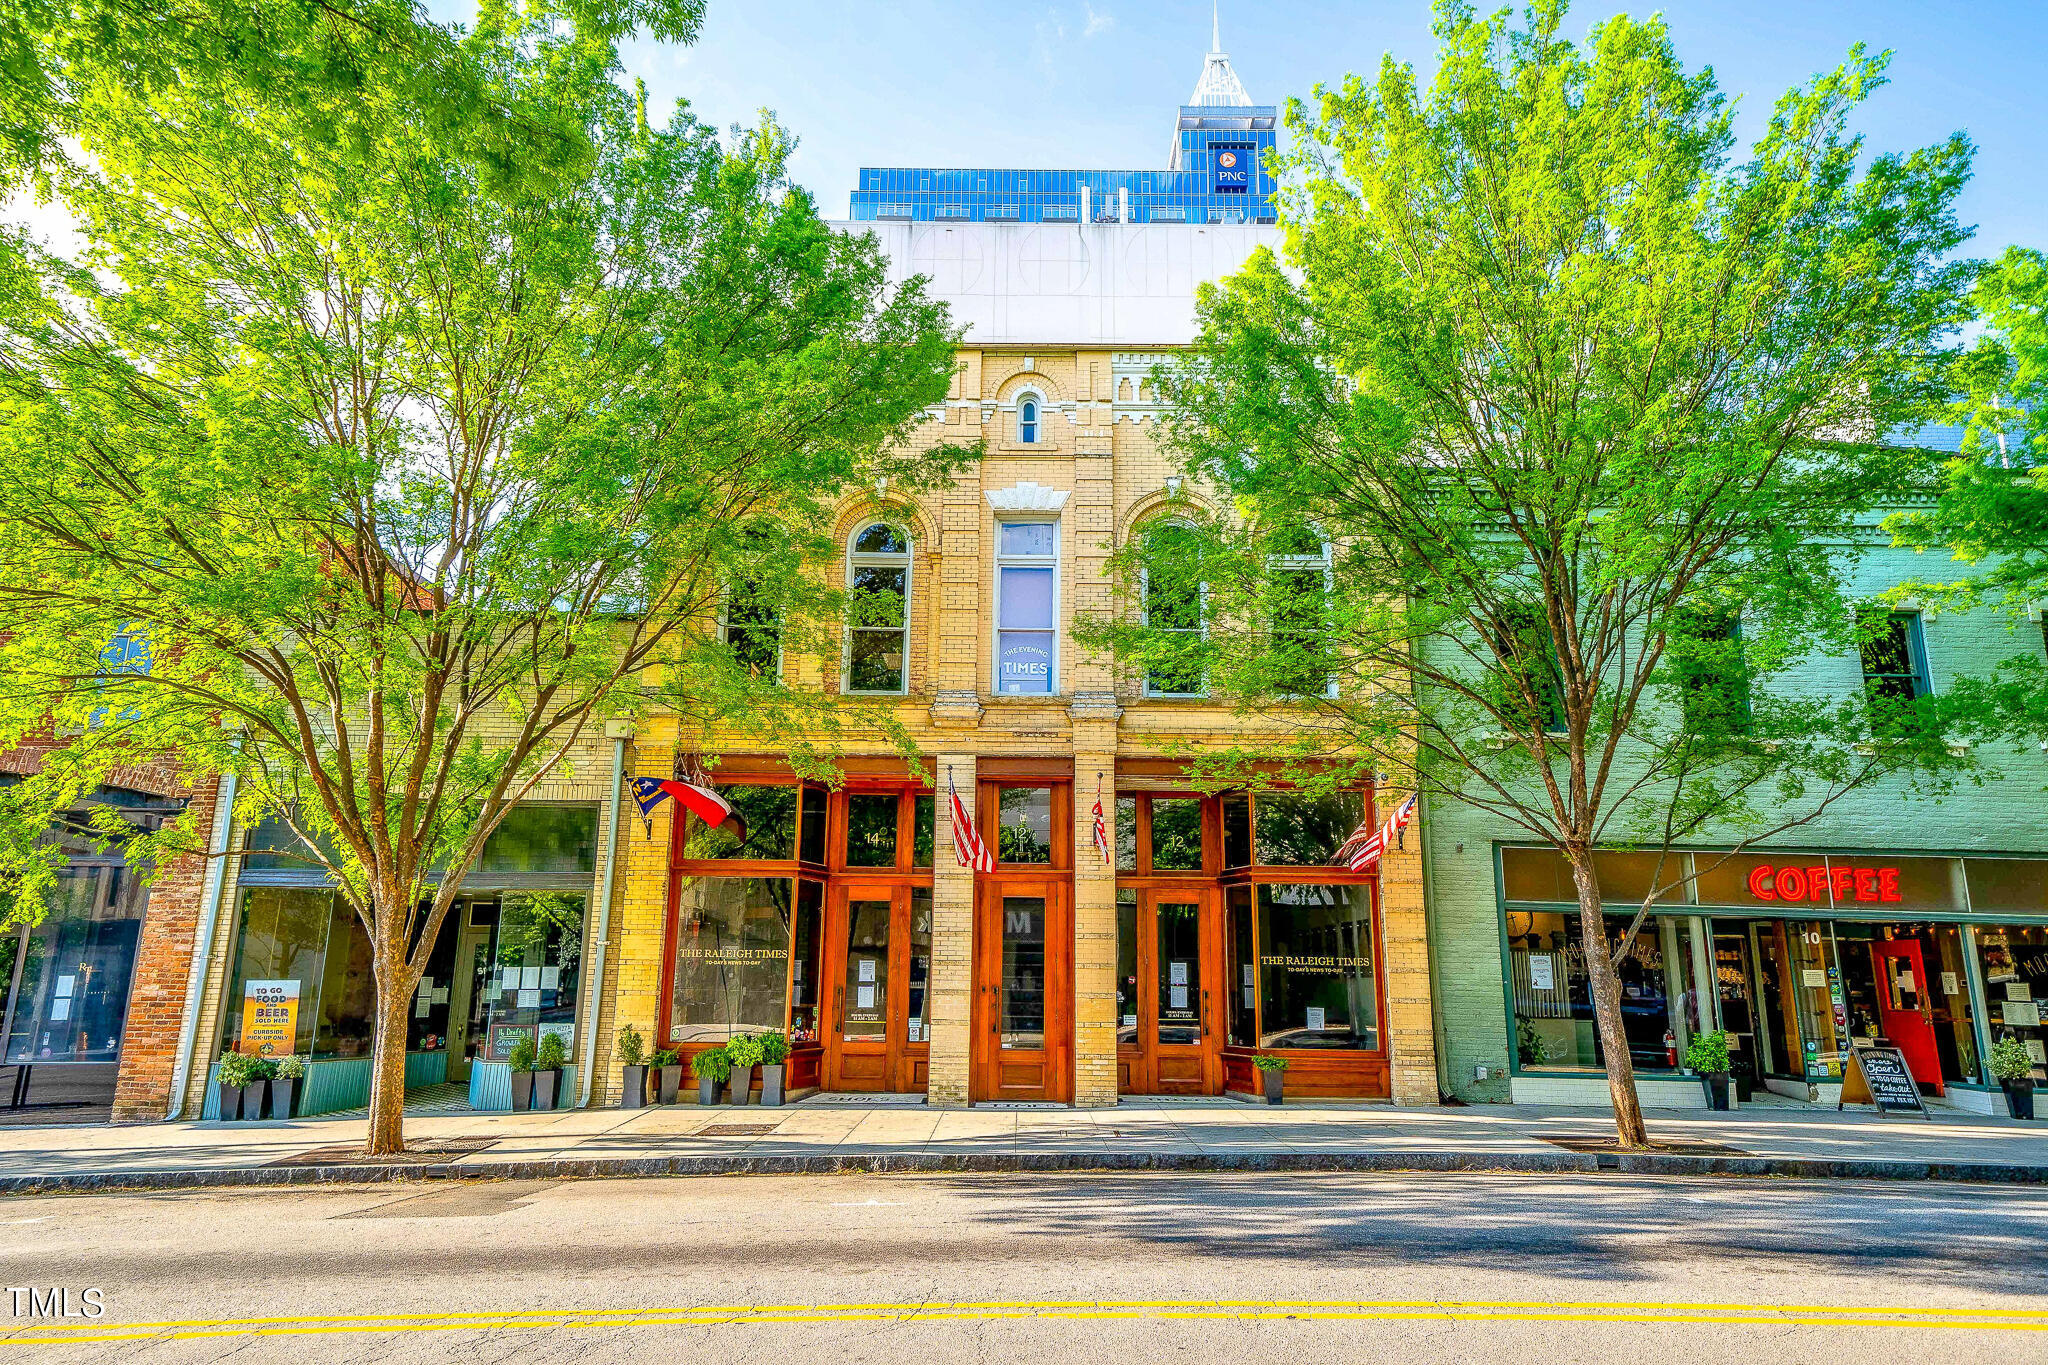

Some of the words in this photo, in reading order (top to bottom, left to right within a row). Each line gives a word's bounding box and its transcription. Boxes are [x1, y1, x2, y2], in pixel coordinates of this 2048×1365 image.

[1218, 171, 1246, 181] PNC
[1004, 647, 1018, 657] THE
[1019, 646, 1049, 658] EVENING
[1003, 662, 1048, 675] TIMES
[1748, 864, 1903, 902] COFFEE
[1802, 931, 1820, 944] 10
[680, 948, 703, 958] THE
[704, 949, 753, 959] RALEIGH
[755, 949, 788, 959] TIMES
[1261, 956, 1284, 966] THE
[1286, 956, 1335, 966] RALEIGH
[1336, 957, 1370, 967] TIMES
[256, 995, 287, 1003] FOOD
[256, 1008, 289, 1017] BEER
[1866, 1063, 1900, 1074] Open
